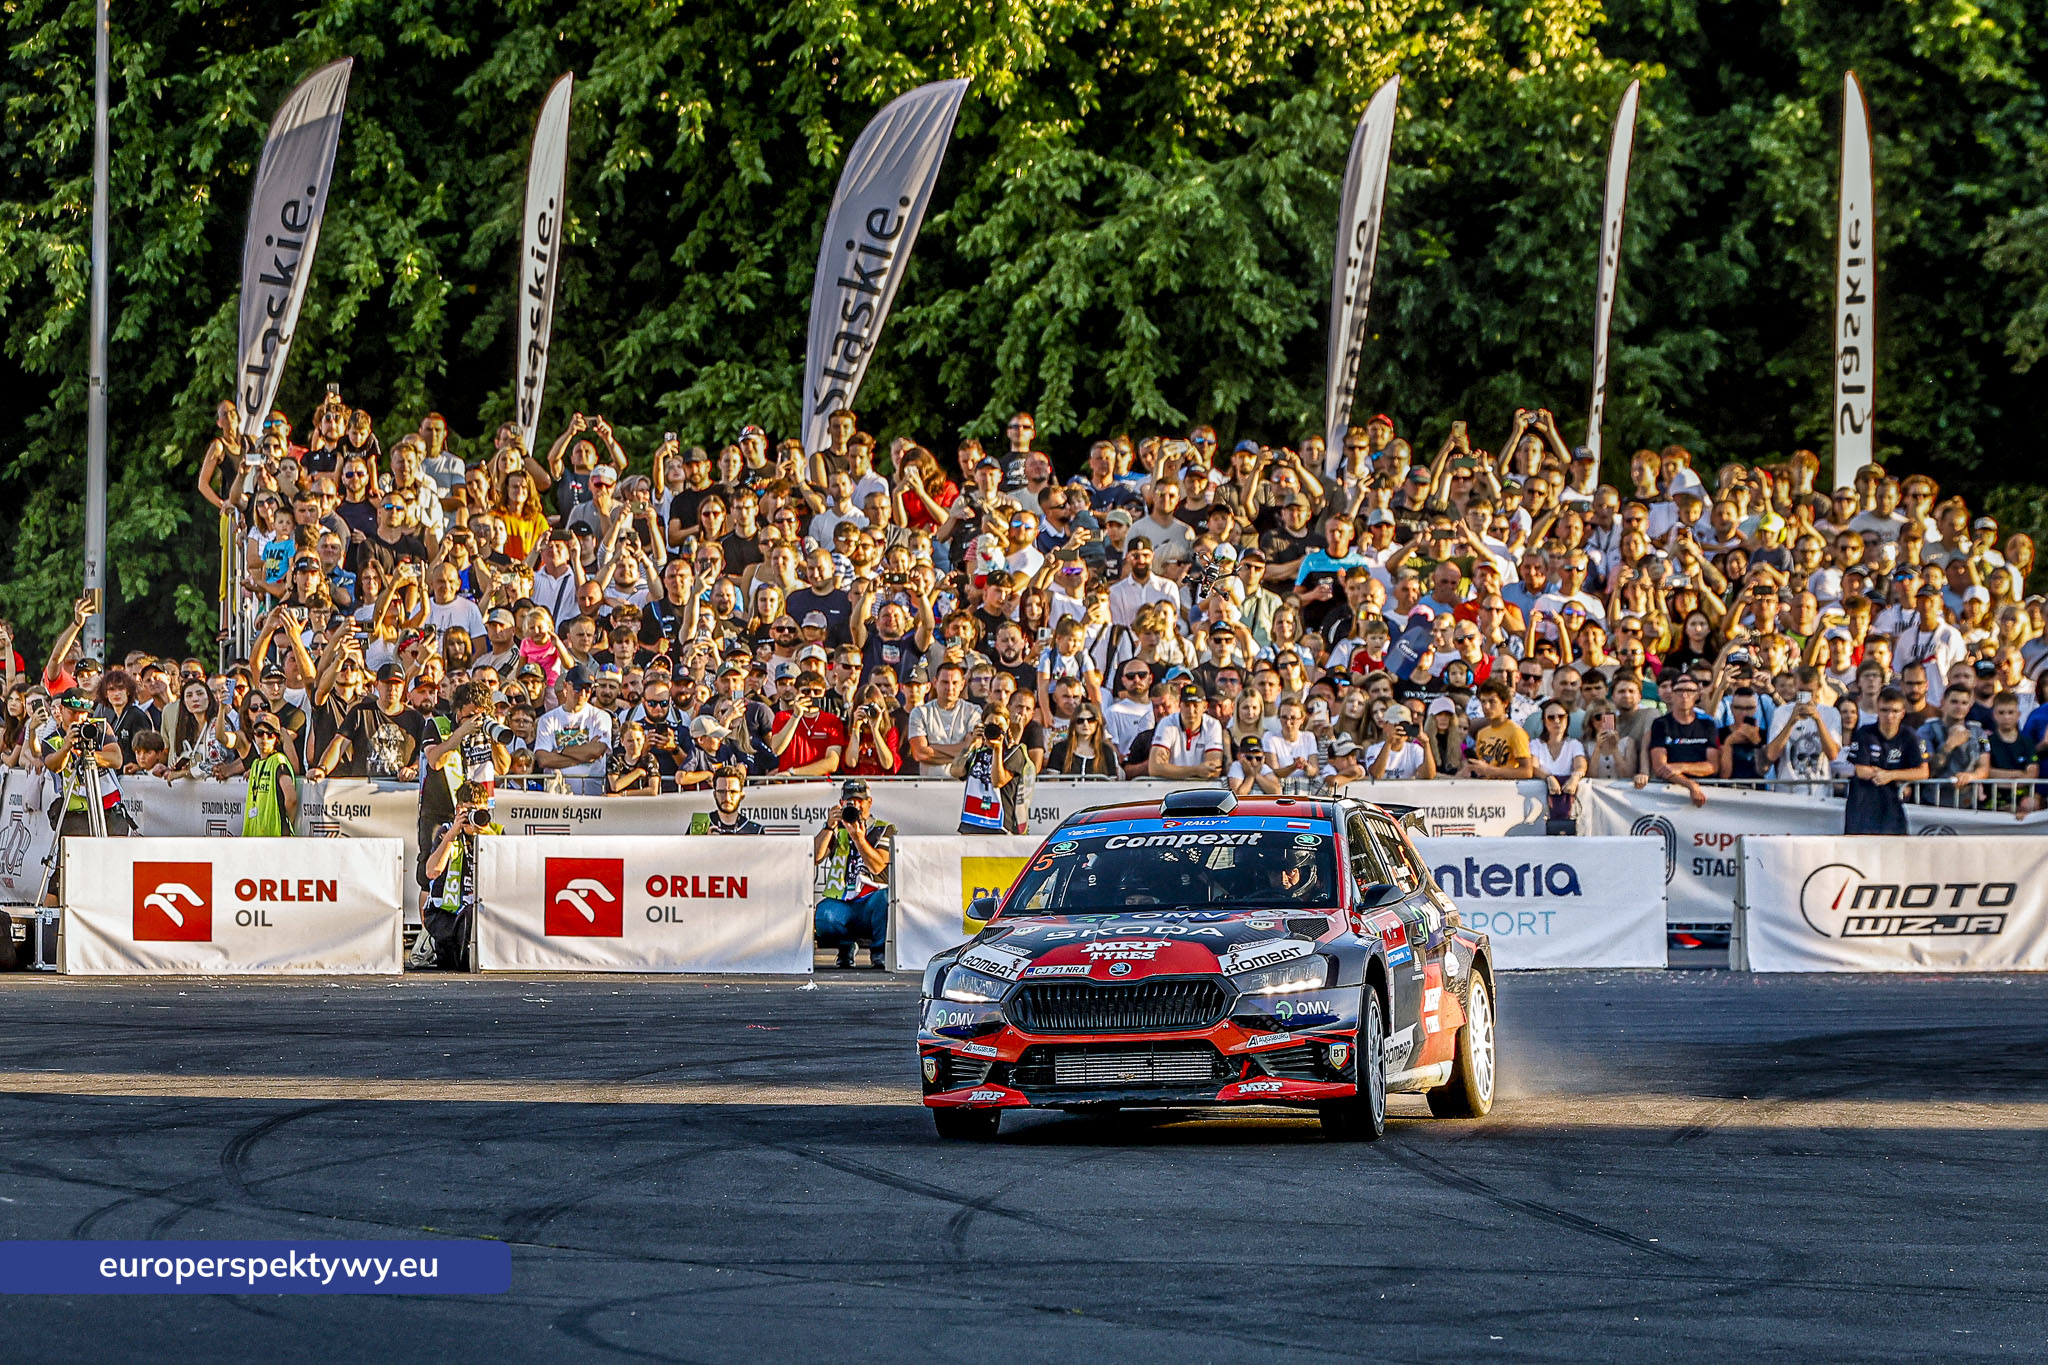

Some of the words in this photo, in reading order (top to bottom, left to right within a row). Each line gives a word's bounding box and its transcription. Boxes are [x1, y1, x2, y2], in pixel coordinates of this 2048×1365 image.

[332, 801, 371, 822] ŚLĄSKI
[510, 807, 559, 819] STADION
[562, 803, 602, 824] ŚLĄSKI
[740, 807, 788, 820] STADION
[1027, 807, 1060, 824] LĄSKI
[1424, 806, 1465, 819] TADION
[1467, 803, 1506, 822] ŚLĄSKI
[1104, 832, 1263, 850] Compexit
[1033, 853, 1057, 871] 5
[1692, 857, 1738, 877] STAD
[1430, 856, 1582, 897] nteria
[235, 879, 338, 902] ORLEN
[645, 874, 749, 899] ORLEN
[1851, 882, 2018, 909] MOTO
[235, 910, 273, 927] OIL
[645, 905, 684, 923] OIL
[1843, 914, 2007, 937] WIZJA
[1080, 941, 1172, 953] MRF
[1089, 951, 1156, 960] TYRES
[962, 954, 1019, 978] ROMBAT
[1034, 967, 1048, 975] CJ
[1065, 966, 1086, 974] NRA
[1296, 1000, 1330, 1015] OMV
[948, 1012, 975, 1026] OMV
[1333, 1049, 1346, 1057] BT
[926, 1063, 934, 1072] BT
[968, 1091, 1006, 1101] MRF
[1238, 1082, 1284, 1093] MRF
